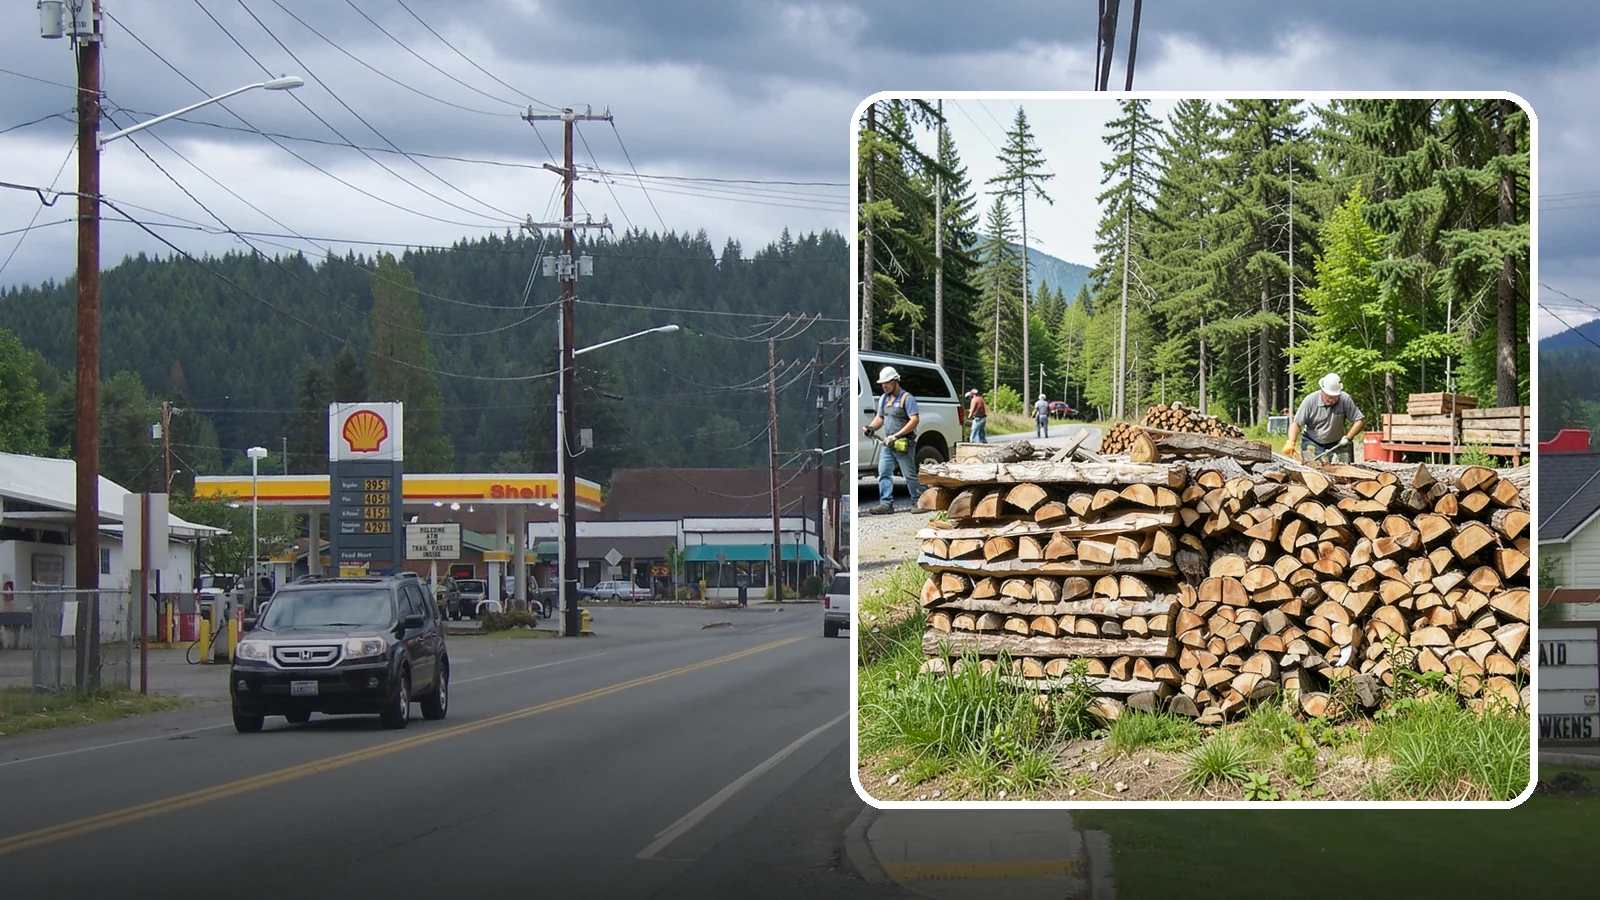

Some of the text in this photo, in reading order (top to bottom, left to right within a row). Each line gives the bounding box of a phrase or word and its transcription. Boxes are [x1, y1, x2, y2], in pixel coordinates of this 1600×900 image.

[365, 480, 383, 490] 395
[490, 484, 547, 498] Shell
[365, 494, 383, 504] 405
[365, 508, 383, 518] 415
[365, 522, 383, 532] 429
[1539, 643, 1566, 665] AID
